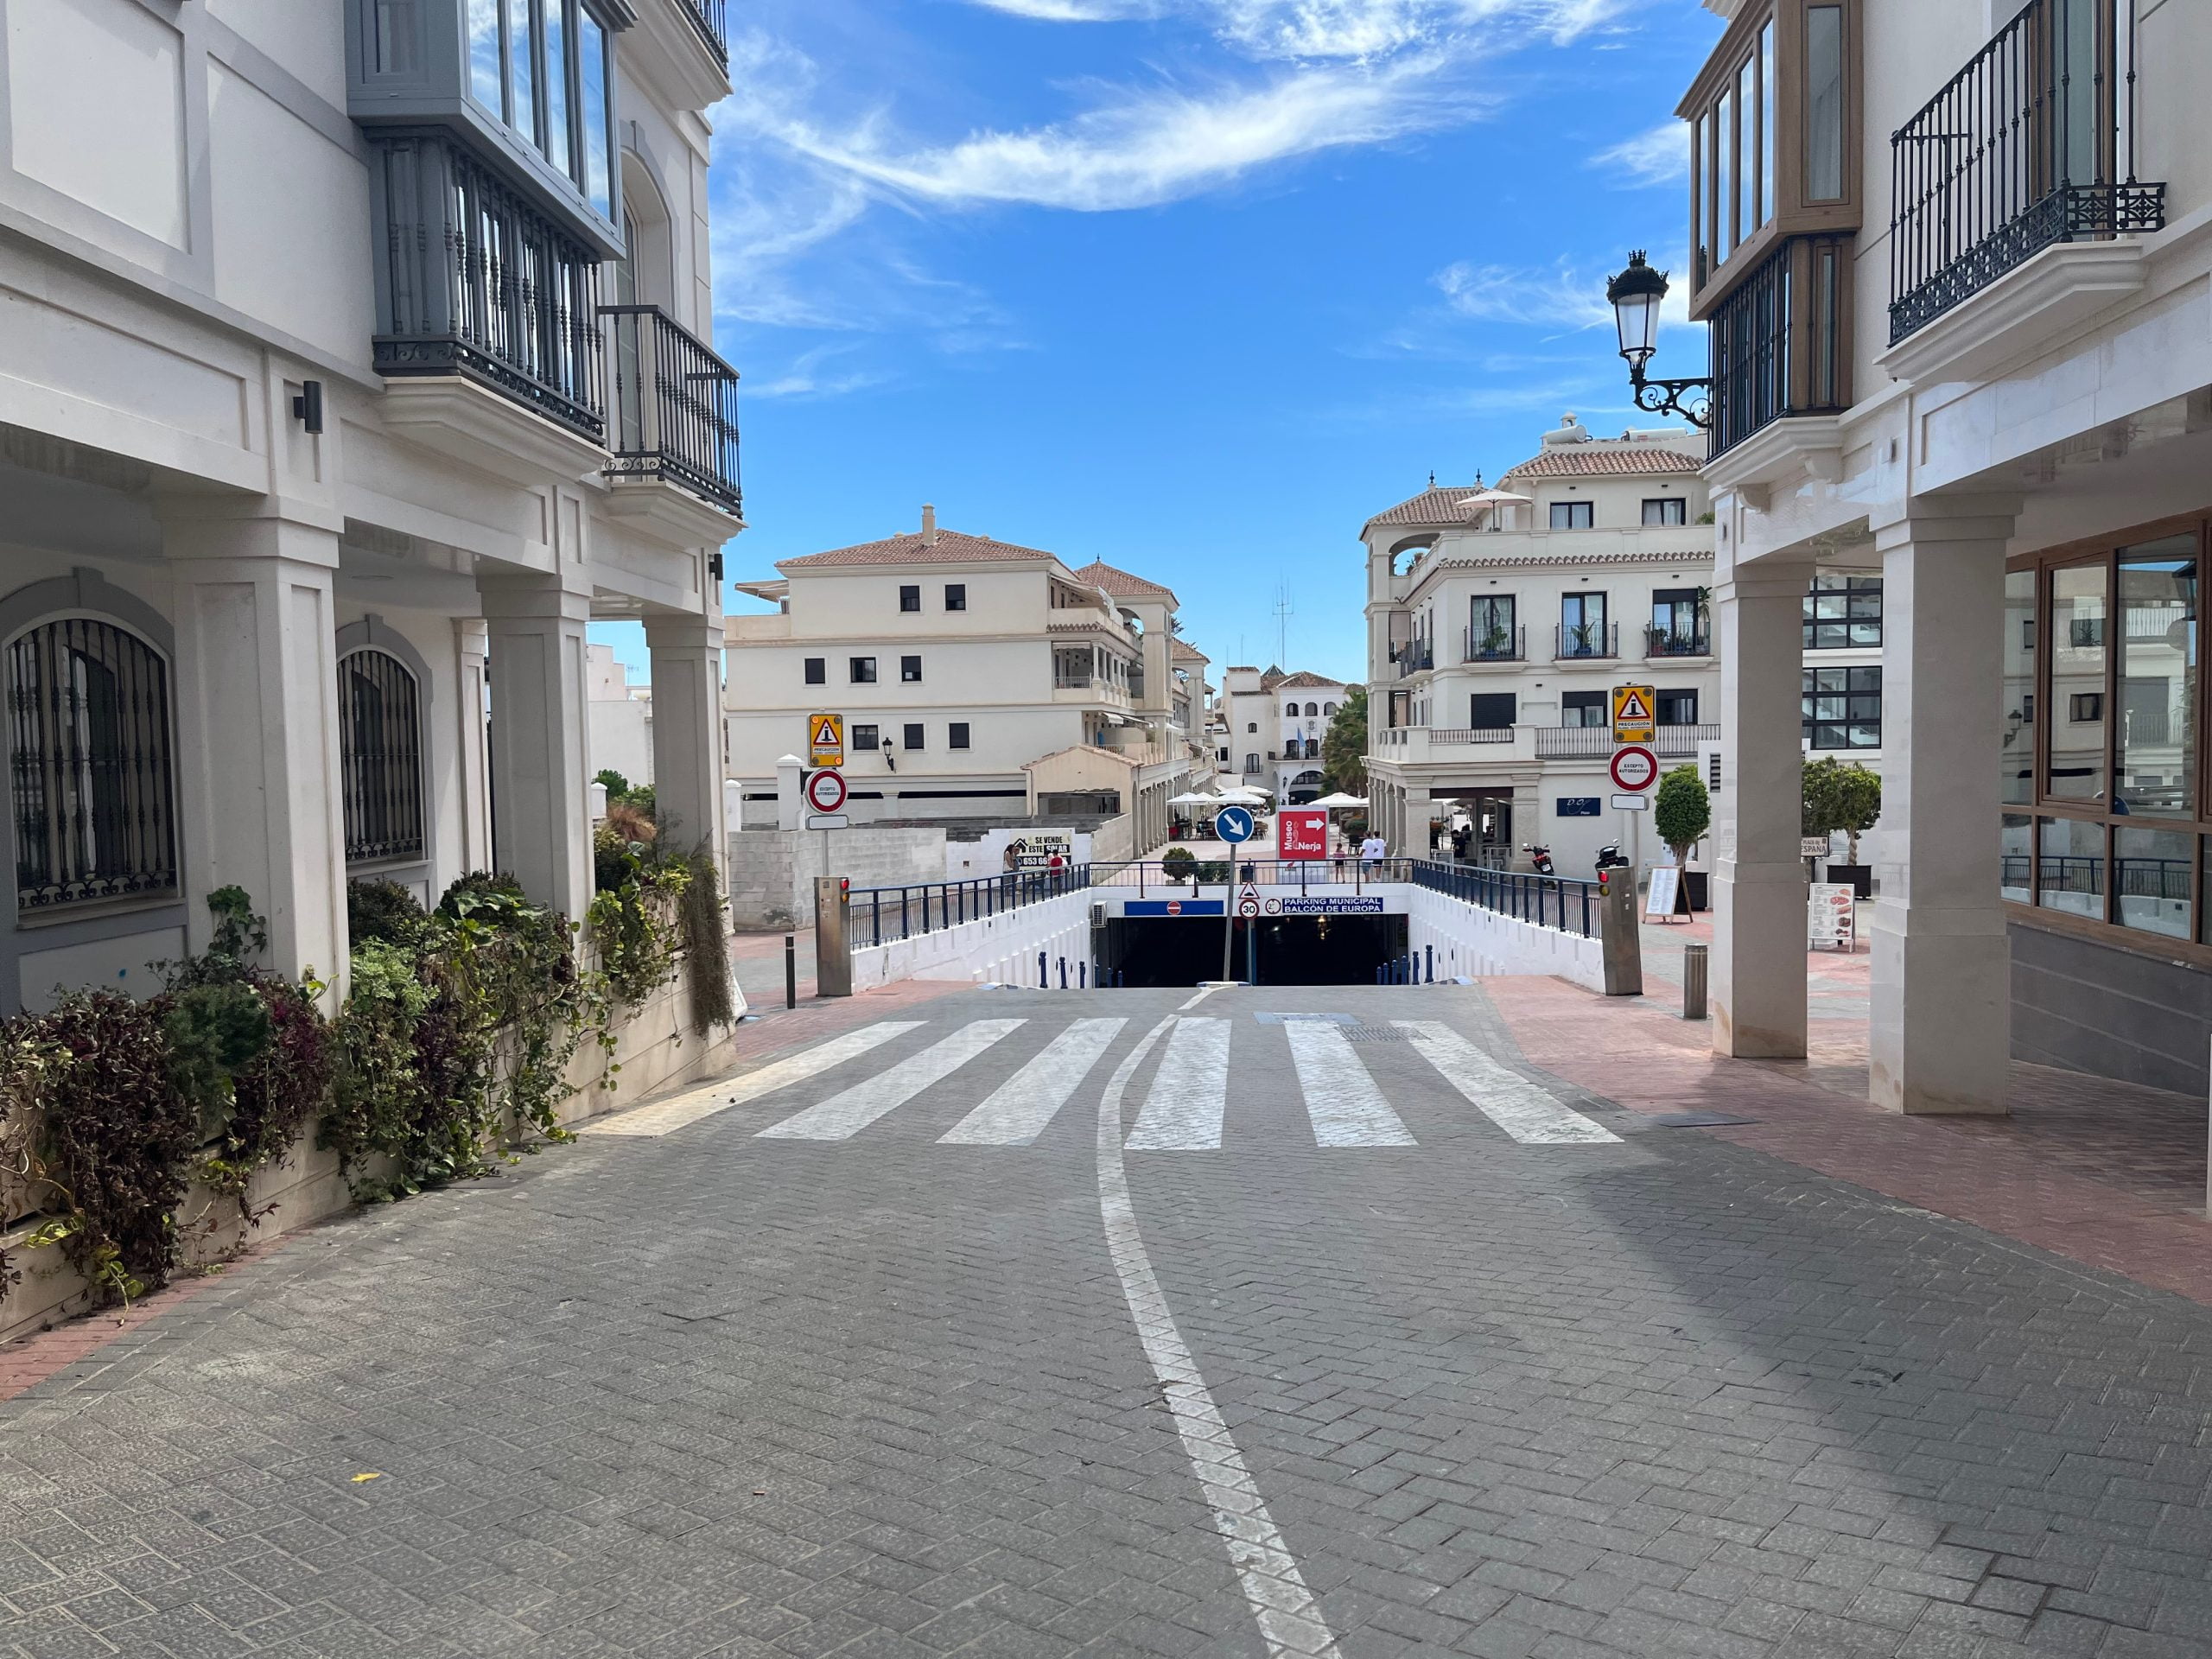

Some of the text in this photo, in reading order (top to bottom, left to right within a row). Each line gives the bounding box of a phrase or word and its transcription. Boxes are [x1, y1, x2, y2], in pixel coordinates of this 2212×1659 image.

[1284, 820, 1293, 850] Museo
[1298, 842, 1321, 852] Nerja
[1023, 857, 1037, 866] 653
